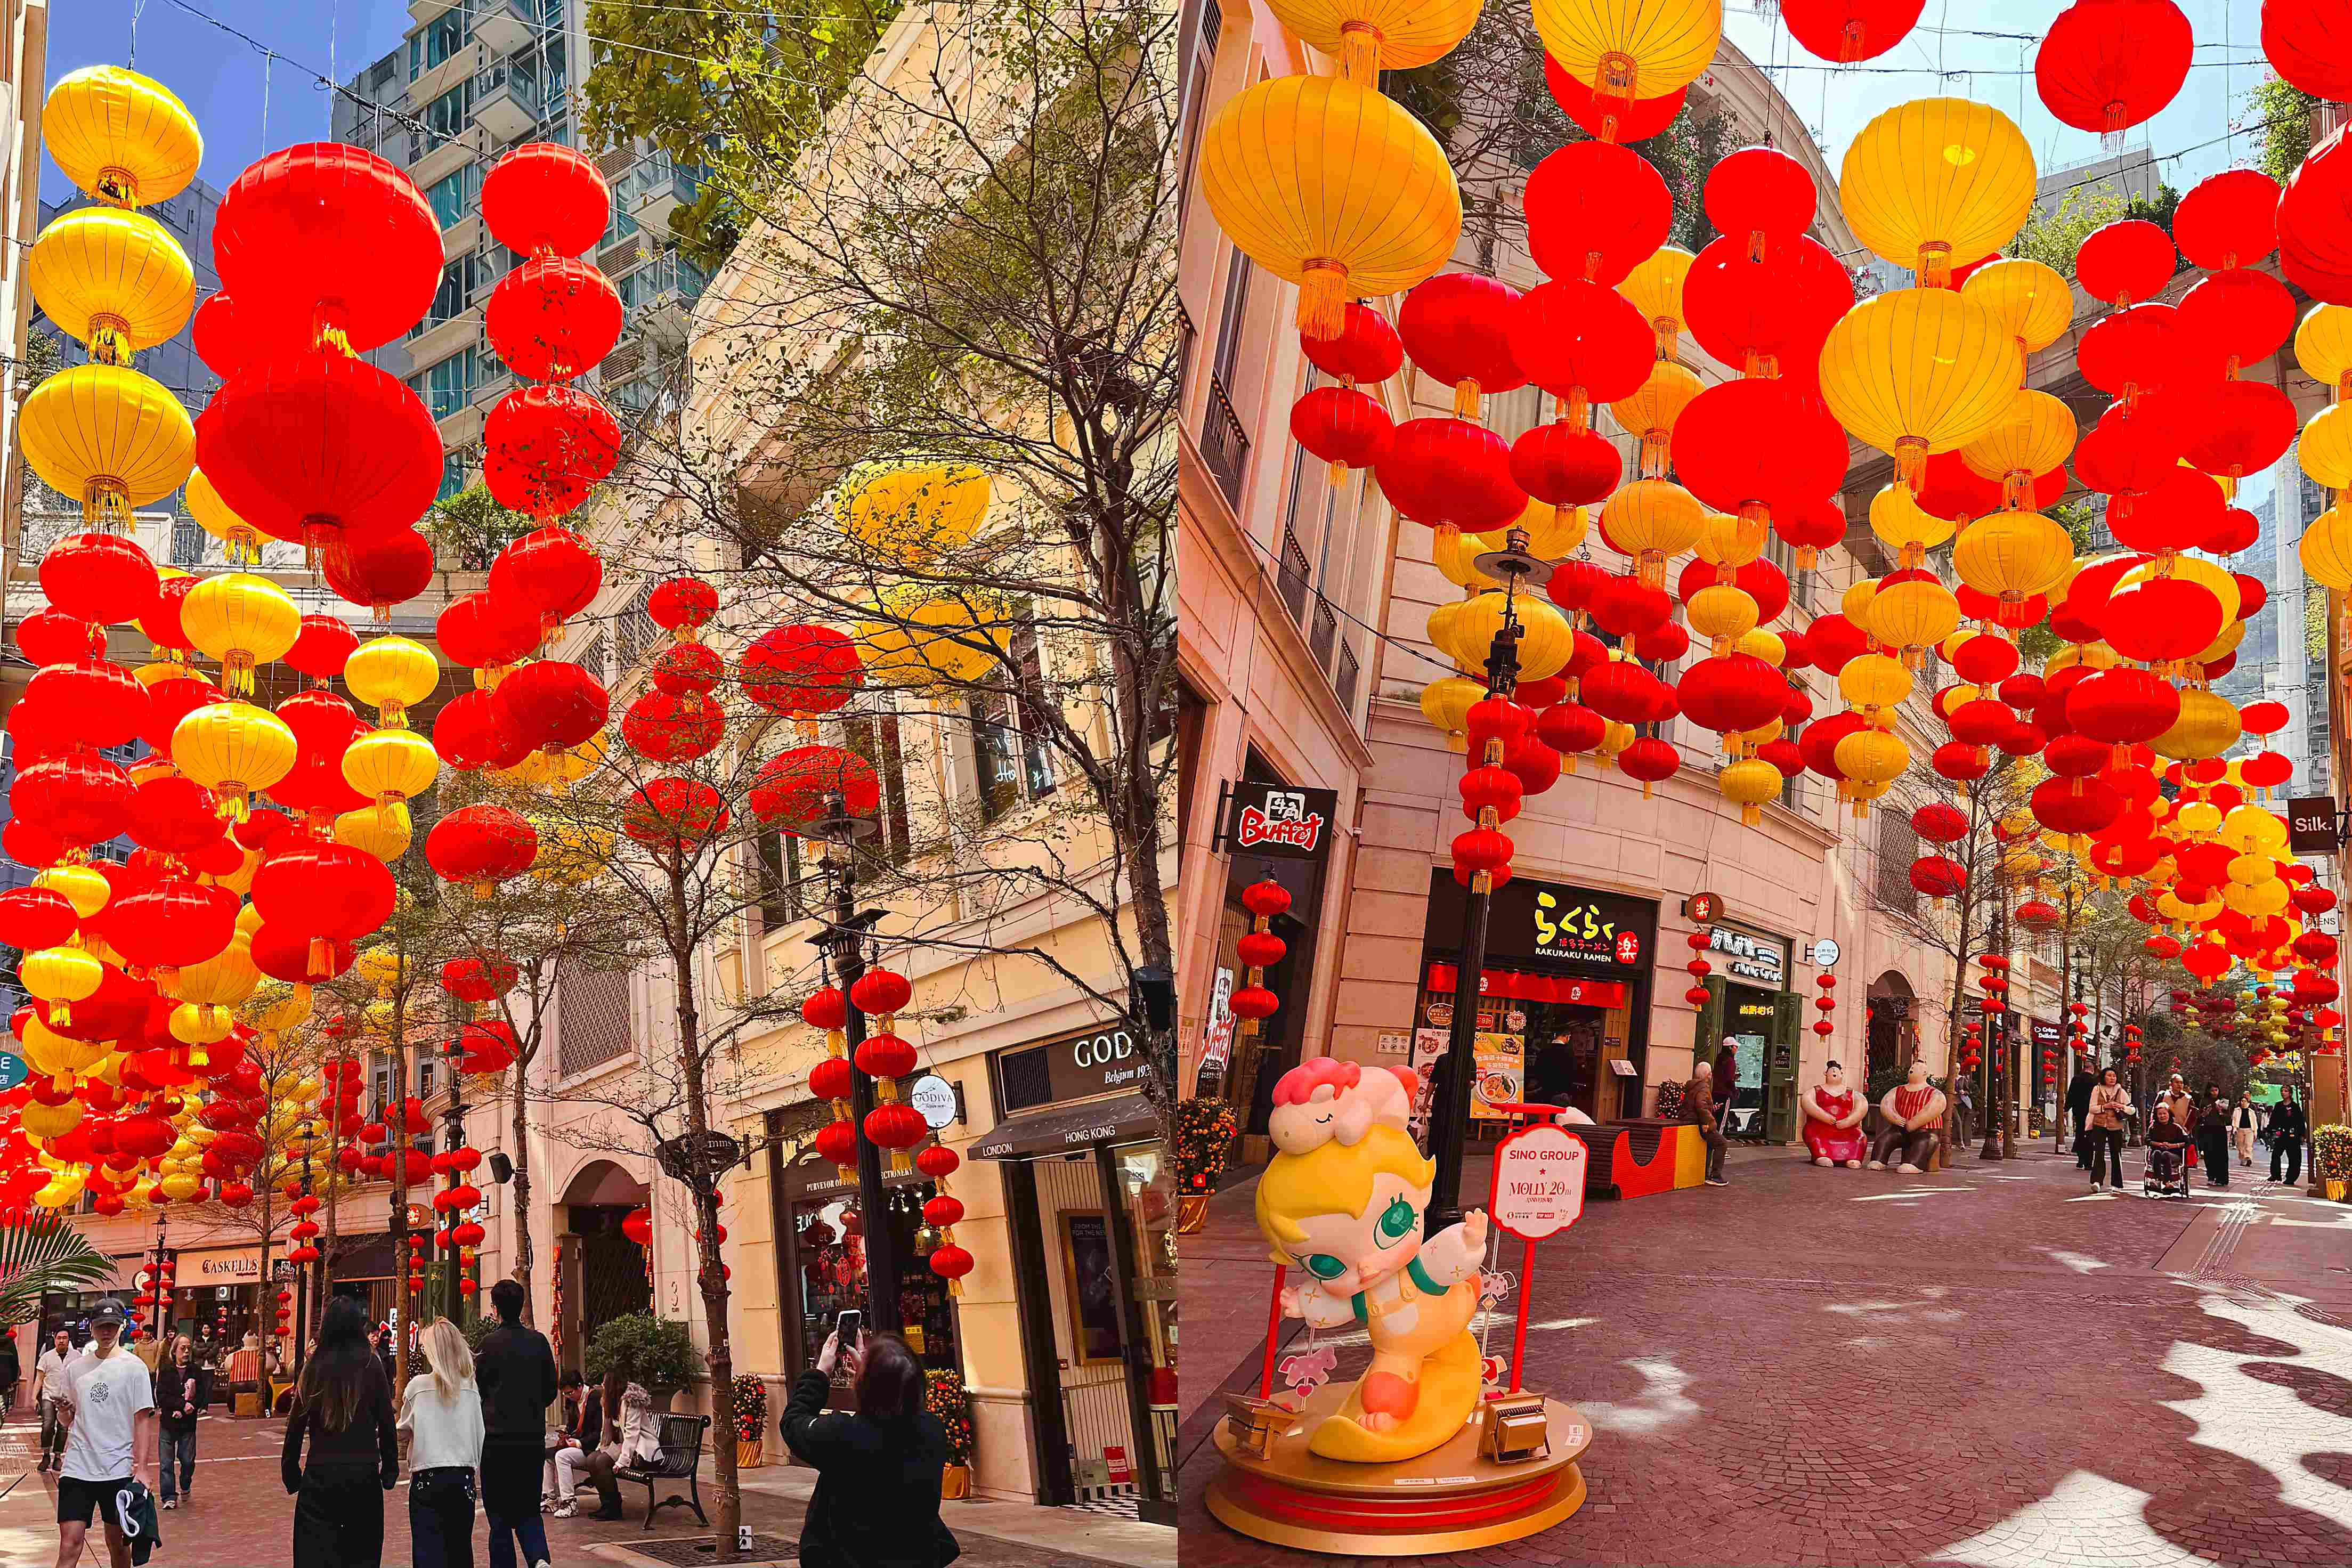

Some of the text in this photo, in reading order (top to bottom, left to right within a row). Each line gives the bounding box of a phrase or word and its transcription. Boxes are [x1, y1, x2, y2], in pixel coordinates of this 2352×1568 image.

[1238, 805, 1324, 851] Buffet
[2295, 816, 2332, 832] Silk.
[1535, 891, 1615, 946] らくらく
[1535, 947, 1611, 963] RAKURAKU RAMEN
[1074, 1031, 1140, 1068] GOD
[1105, 1064, 1151, 1084] Belgium 192
[914, 1093, 953, 1102] GODIVA
[1065, 1125, 1115, 1143] HONG KONG
[982, 1143, 1012, 1157] LONDON
[1509, 1150, 1579, 1160] SINO GROUP
[806, 1182, 834, 1192] PURVEYOR
[880, 1167, 913, 1180] ECTIONERY
[1509, 1182, 1547, 1197] MOLLY
